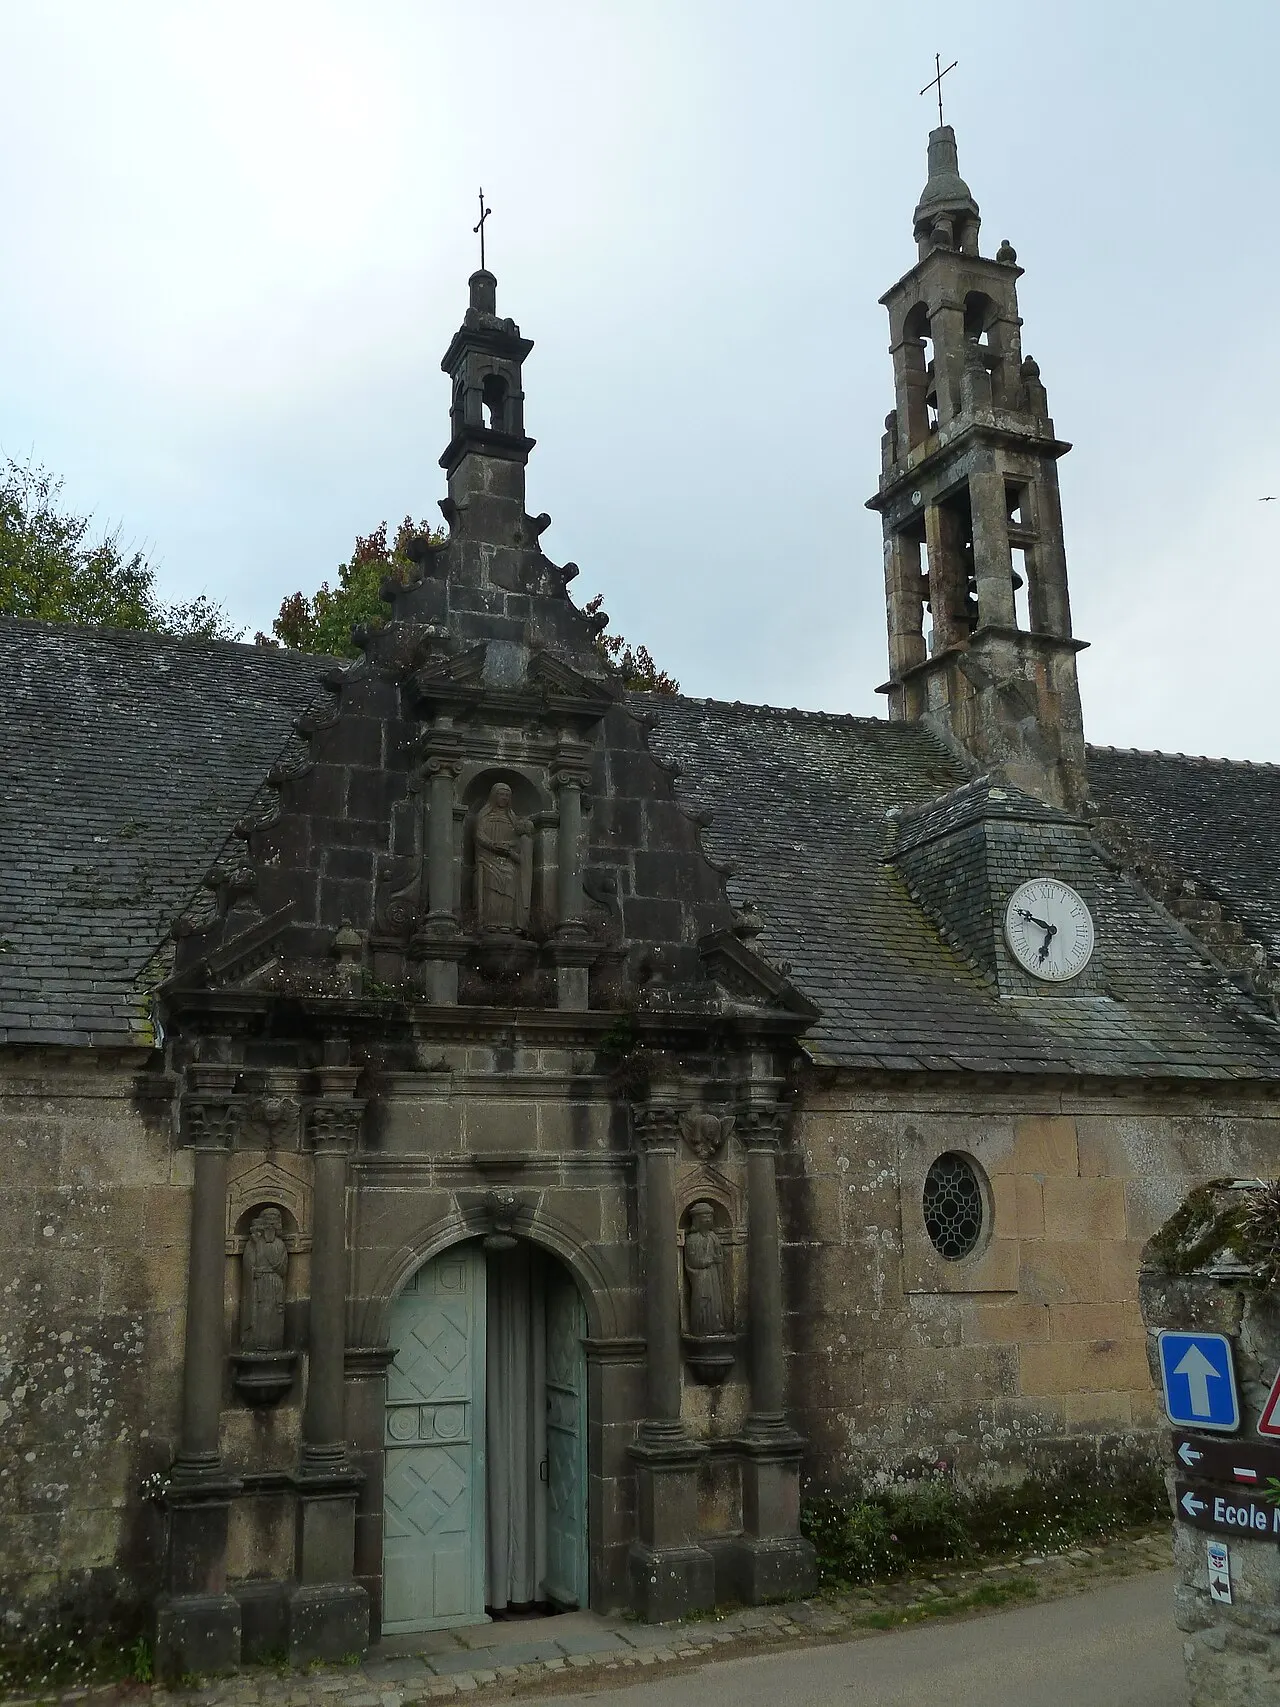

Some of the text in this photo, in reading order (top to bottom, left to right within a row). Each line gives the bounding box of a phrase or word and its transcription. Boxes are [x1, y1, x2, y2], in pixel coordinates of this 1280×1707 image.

[1040, 888, 1054, 899] XII
[1070, 907, 1081, 918] II
[1075, 924, 1086, 938] III
[1214, 1497, 1267, 1530] Ecole
